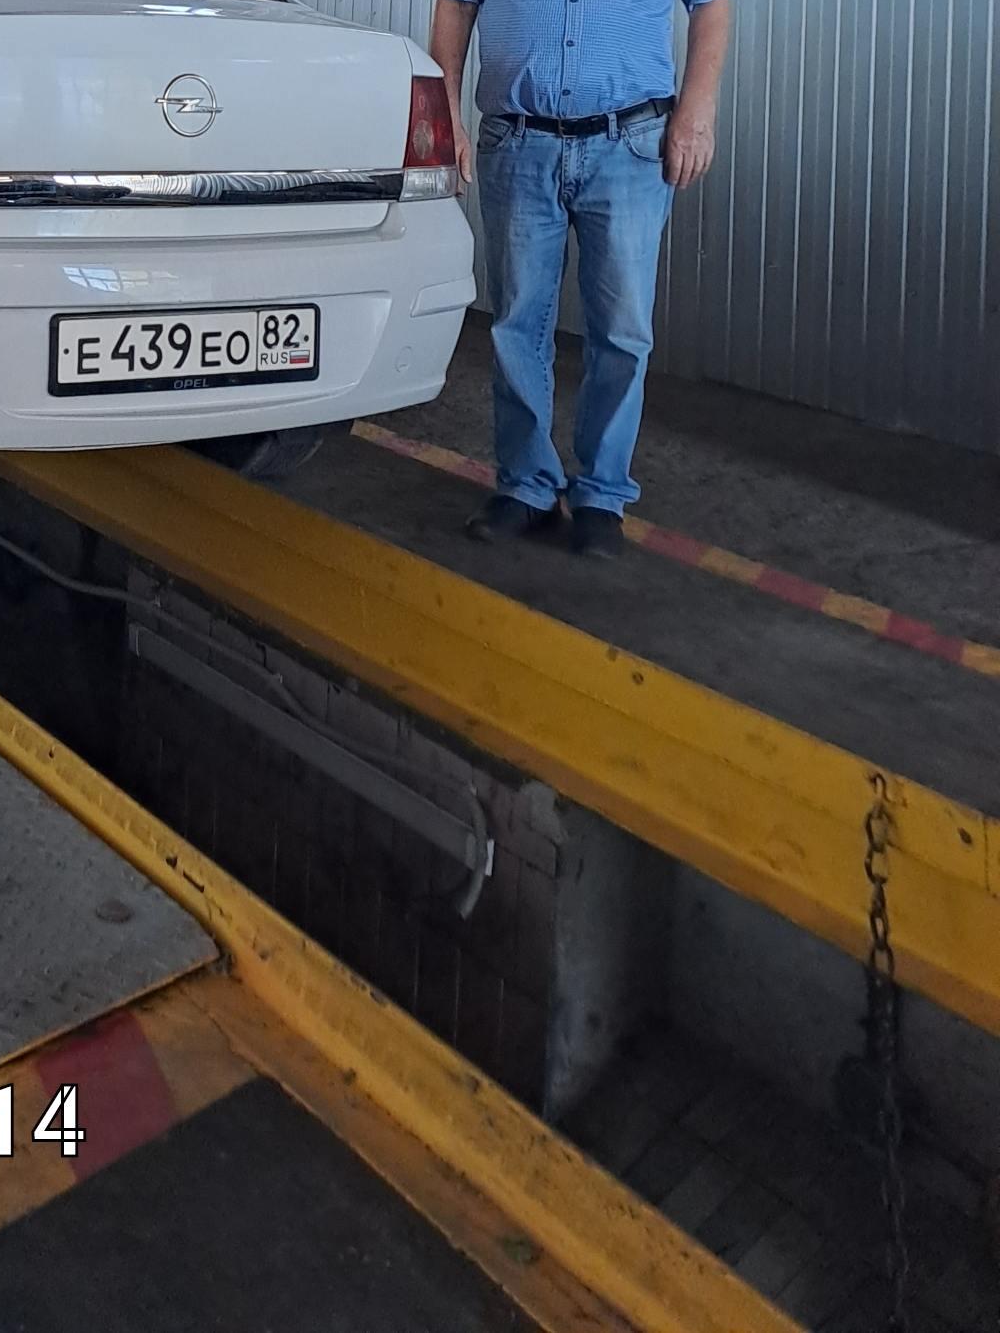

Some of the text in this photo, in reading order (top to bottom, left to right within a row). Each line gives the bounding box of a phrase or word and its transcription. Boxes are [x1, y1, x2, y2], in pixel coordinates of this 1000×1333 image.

[262, 313, 301, 349] 82
[260, 350, 288, 366] RUS
[173, 377, 210, 390] OPEL
